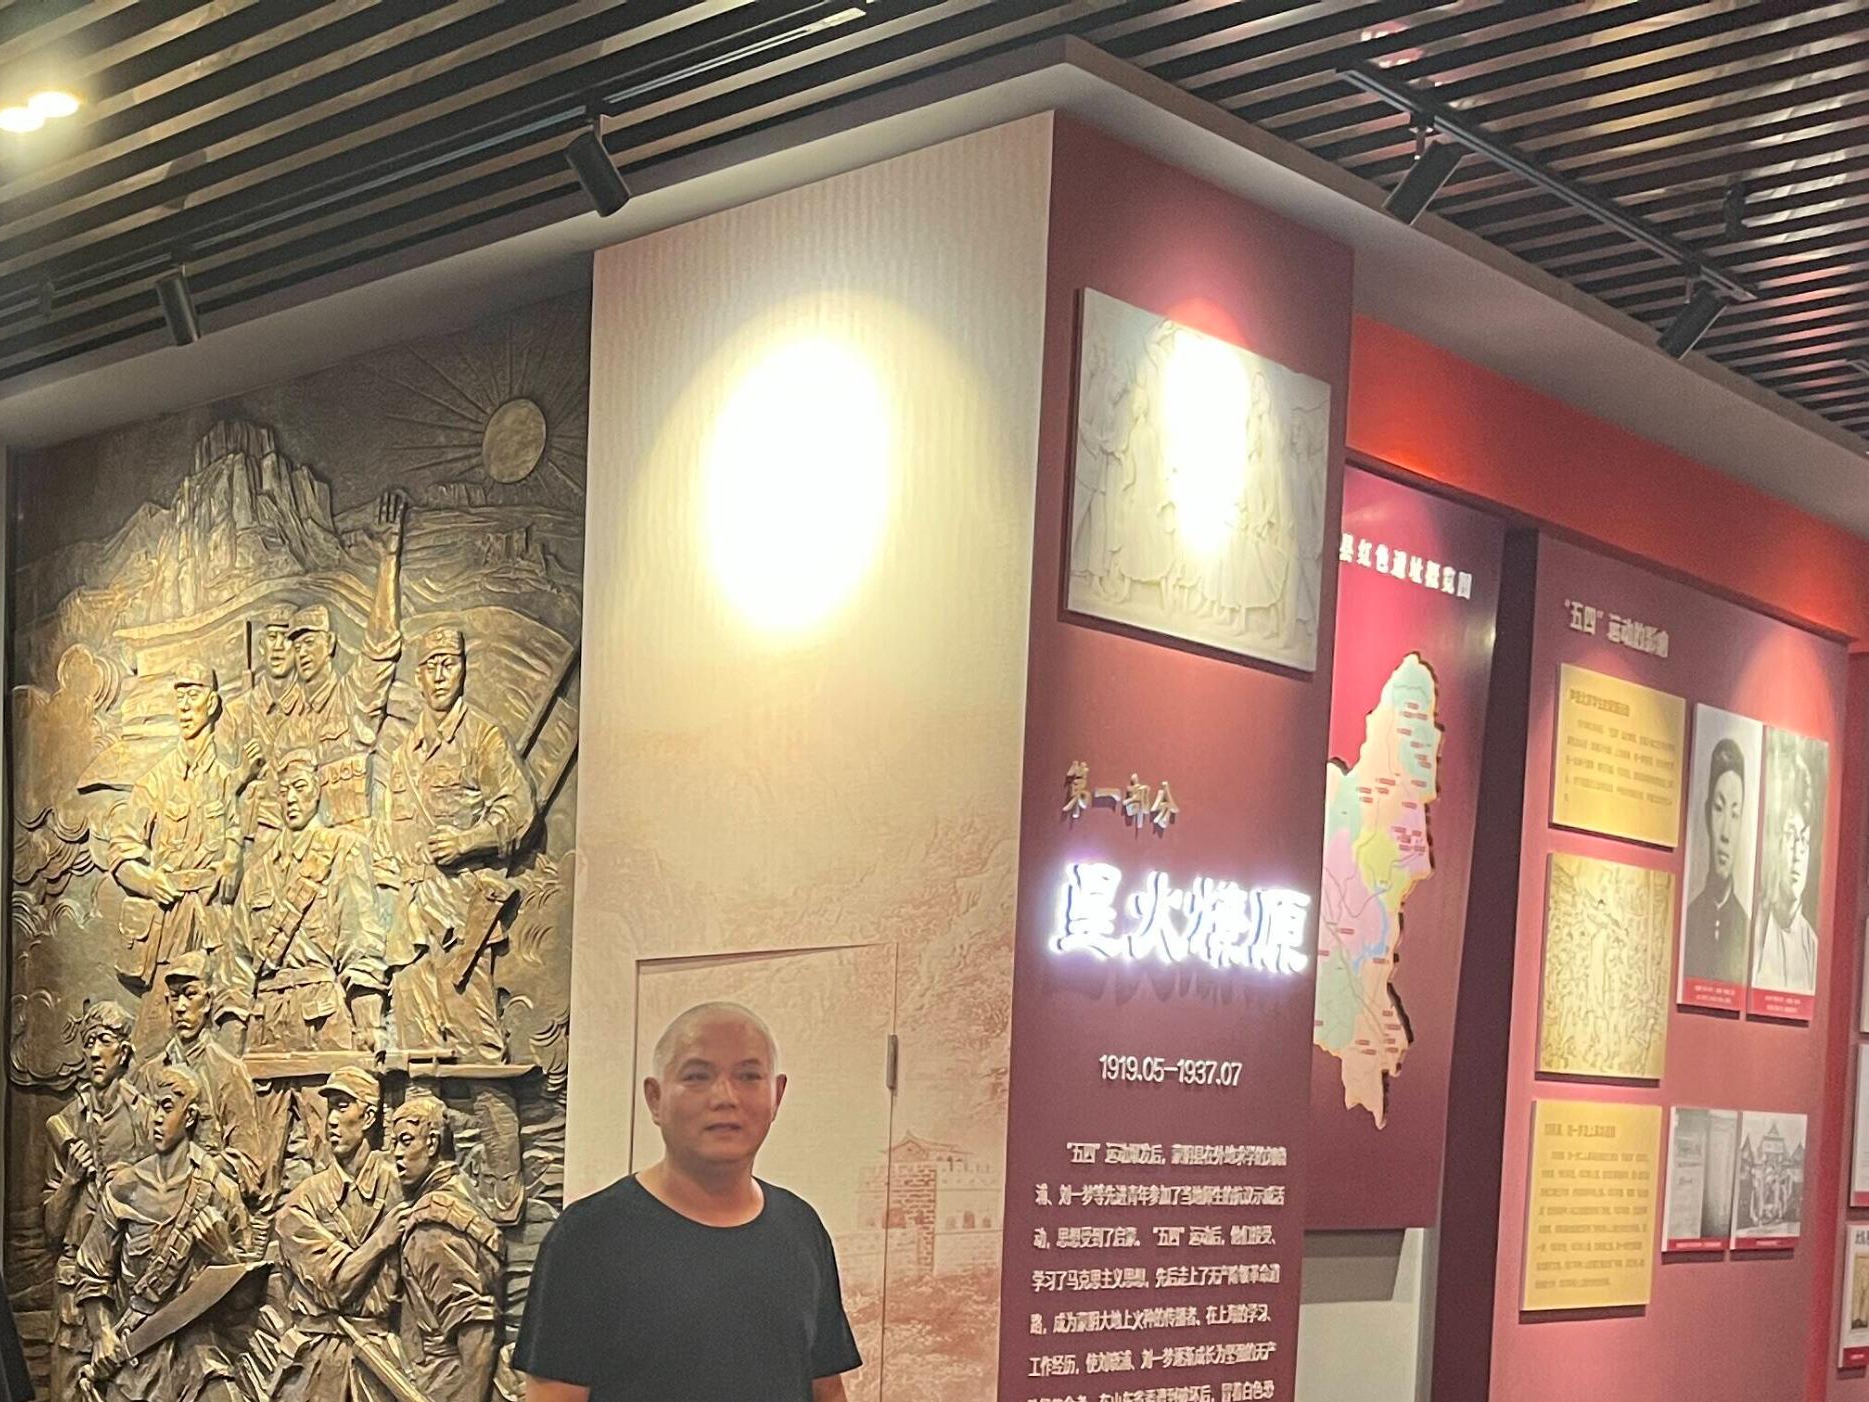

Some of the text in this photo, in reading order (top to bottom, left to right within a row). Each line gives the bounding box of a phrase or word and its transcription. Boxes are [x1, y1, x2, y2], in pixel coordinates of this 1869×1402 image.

[1062, 760, 1180, 829] 第一部分
[1052, 864, 1311, 974] 星火燎原
